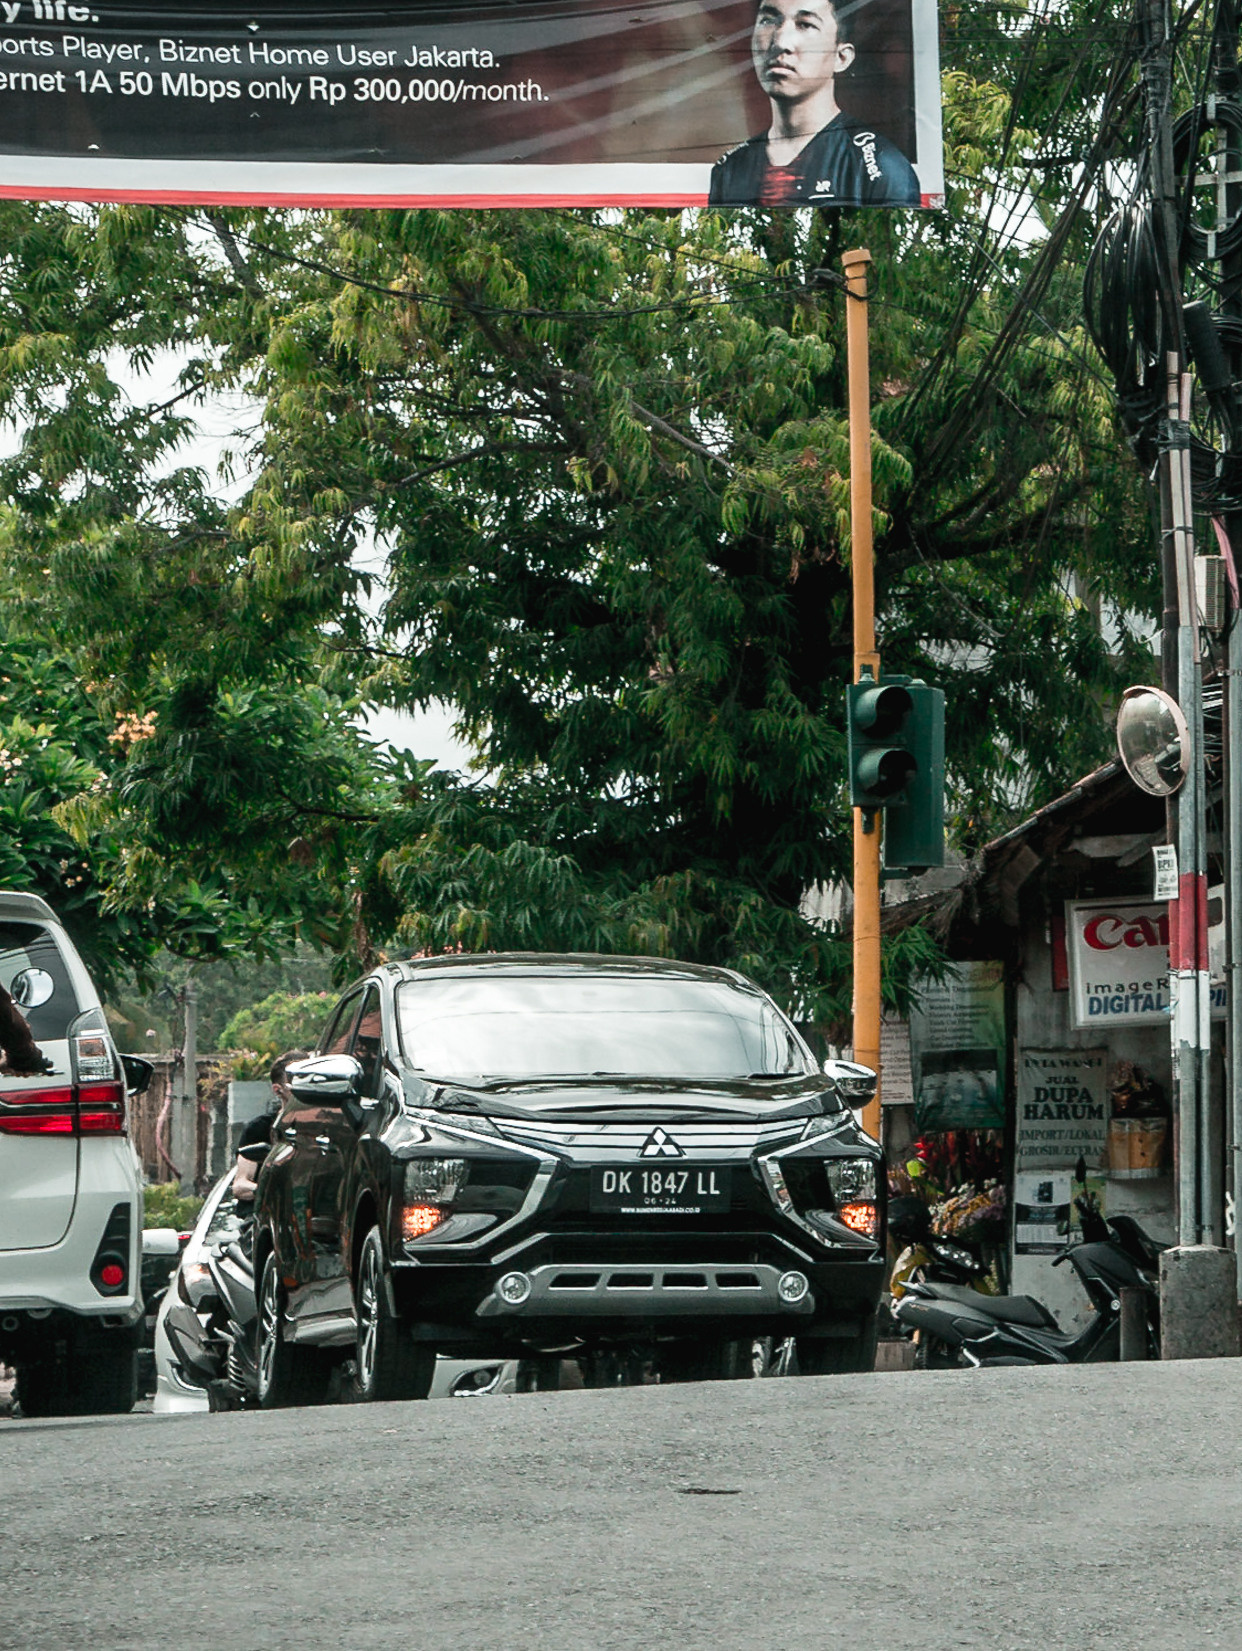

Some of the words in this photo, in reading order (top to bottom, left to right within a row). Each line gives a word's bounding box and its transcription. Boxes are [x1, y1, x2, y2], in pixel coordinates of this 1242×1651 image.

[0, 37, 54, 56] orts
[63, 35, 150, 63] Player,
[159, 39, 242, 64] Biznet
[249, 42, 330, 65] Home
[336, 44, 397, 66] User
[404, 45, 500, 68] Jakarta.
[75, 69, 113, 95] 1A
[119, 71, 153, 95] 50
[162, 72, 241, 103] Mbps
[248, 76, 302, 105] only
[309, 76, 346, 106] Rp
[353, 77, 549, 104] 300,000/month.
[861, 142, 883, 182] Biznet
[1088, 992, 1168, 1016] DIGITAL
[1046, 1076, 1080, 1085] JUAL
[1033, 1086, 1094, 1103] DUPA
[1023, 1103, 1104, 1120] HARUM
[602, 1170, 633, 1194] DK
[641, 1171, 690, 1195] 1847
[697, 1171, 721, 1195] LL
